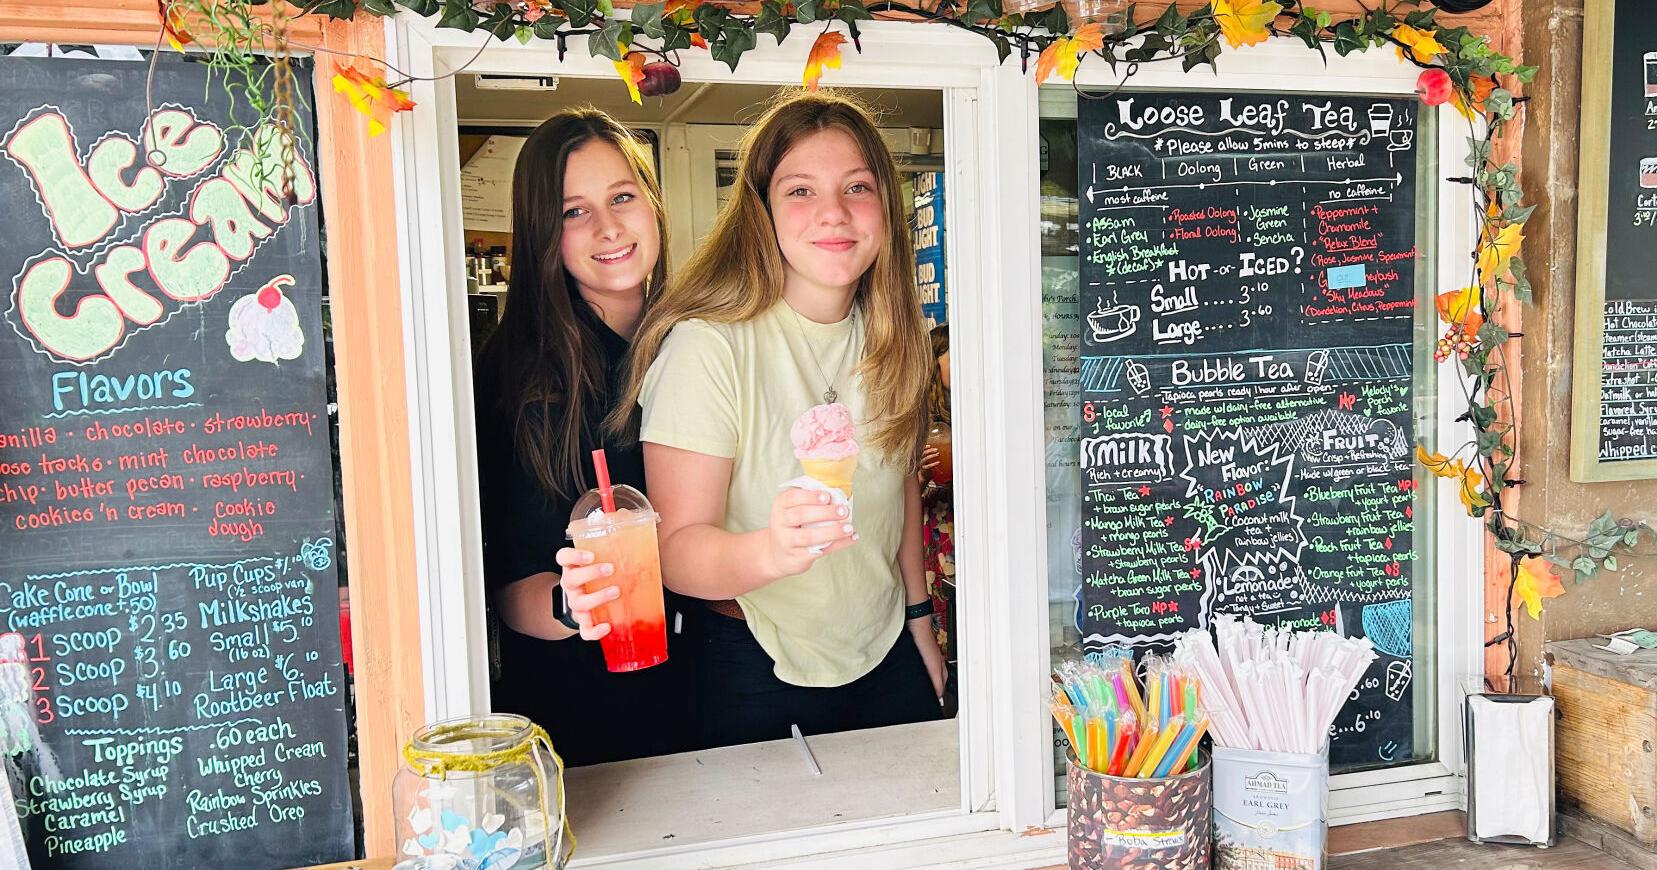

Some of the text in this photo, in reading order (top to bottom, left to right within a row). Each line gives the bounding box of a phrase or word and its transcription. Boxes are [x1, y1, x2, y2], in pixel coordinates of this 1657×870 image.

[1117, 98, 1357, 136] Loose Leaf Tea
[1217, 137, 1248, 151] allow
[1295, 138, 1308, 150] to
[1106, 164, 1143, 181] BLACK
[1178, 161, 1221, 182] Oolong
[1248, 157, 1285, 171] Green
[1327, 153, 1365, 171] Herbal
[8, 109, 223, 248] Ice
[1104, 189, 1169, 205] most caffeine
[1328, 184, 1386, 199] no caffeine
[917, 206, 935, 229] BUD
[1093, 217, 1135, 232] Assam
[1207, 207, 1236, 224] Oolong
[1248, 205, 1289, 220] Jasmine
[1256, 218, 1287, 231] Green
[18, 122, 316, 361] Cream
[915, 226, 939, 250] LIGHT
[1093, 229, 1149, 247] Earl Grey
[1205, 226, 1237, 244] Oolong
[1093, 249, 1129, 267] English
[919, 262, 935, 284] BUD
[1150, 284, 1199, 313] Small
[1152, 318, 1202, 345] Large
[1171, 355, 1294, 386] Bubble Tea
[52, 368, 195, 411] Flavors
[1083, 402, 1096, 422] S
[86, 417, 185, 441] chocolate
[204, 408, 313, 437] strawberry
[38, 441, 279, 475] tracks mint chocolate
[1198, 442, 1234, 467] New
[55, 477, 115, 500] butter
[127, 474, 184, 500] pecan
[203, 467, 297, 492] raspberry
[1117, 487, 1139, 500] Tea
[1378, 482, 1398, 494] Tea
[15, 503, 185, 530] cookies cream
[1125, 515, 1146, 530] Milk
[1146, 516, 1165, 528] Tea
[1382, 510, 1404, 520] Tea
[208, 518, 264, 542] dough
[1166, 541, 1185, 553] Tea
[1363, 538, 1384, 550] Tea
[189, 564, 275, 591] Pup Cups
[1172, 569, 1190, 579] Tea
[1223, 572, 1294, 596] Lemonade
[1367, 567, 1385, 577] Tea
[54, 581, 95, 604] Cone
[100, 585, 115, 595] or
[116, 572, 158, 598] Bowl
[251, 582, 283, 594] scoop
[199, 594, 314, 629] Milkshakes
[1090, 604, 1128, 621] Purple
[30, 633, 51, 662] 1
[209, 622, 270, 651] Small
[32, 667, 50, 690] 2
[209, 667, 269, 695] Large
[193, 672, 337, 719] Rootbeer Float
[36, 697, 55, 723] 3
[82, 716, 297, 767] Toppings each
[197, 741, 327, 777] Whipped Cream
[29, 765, 169, 797] Chocolate Syrup
[15, 784, 167, 818] Strawberry Syrup
[186, 789, 246, 814] Rainbow
[1243, 799, 1289, 809] EARL GREY
[44, 806, 125, 832] Caramel
[187, 804, 305, 839] Crushed Oreo
[44, 825, 127, 857] Pineapple
